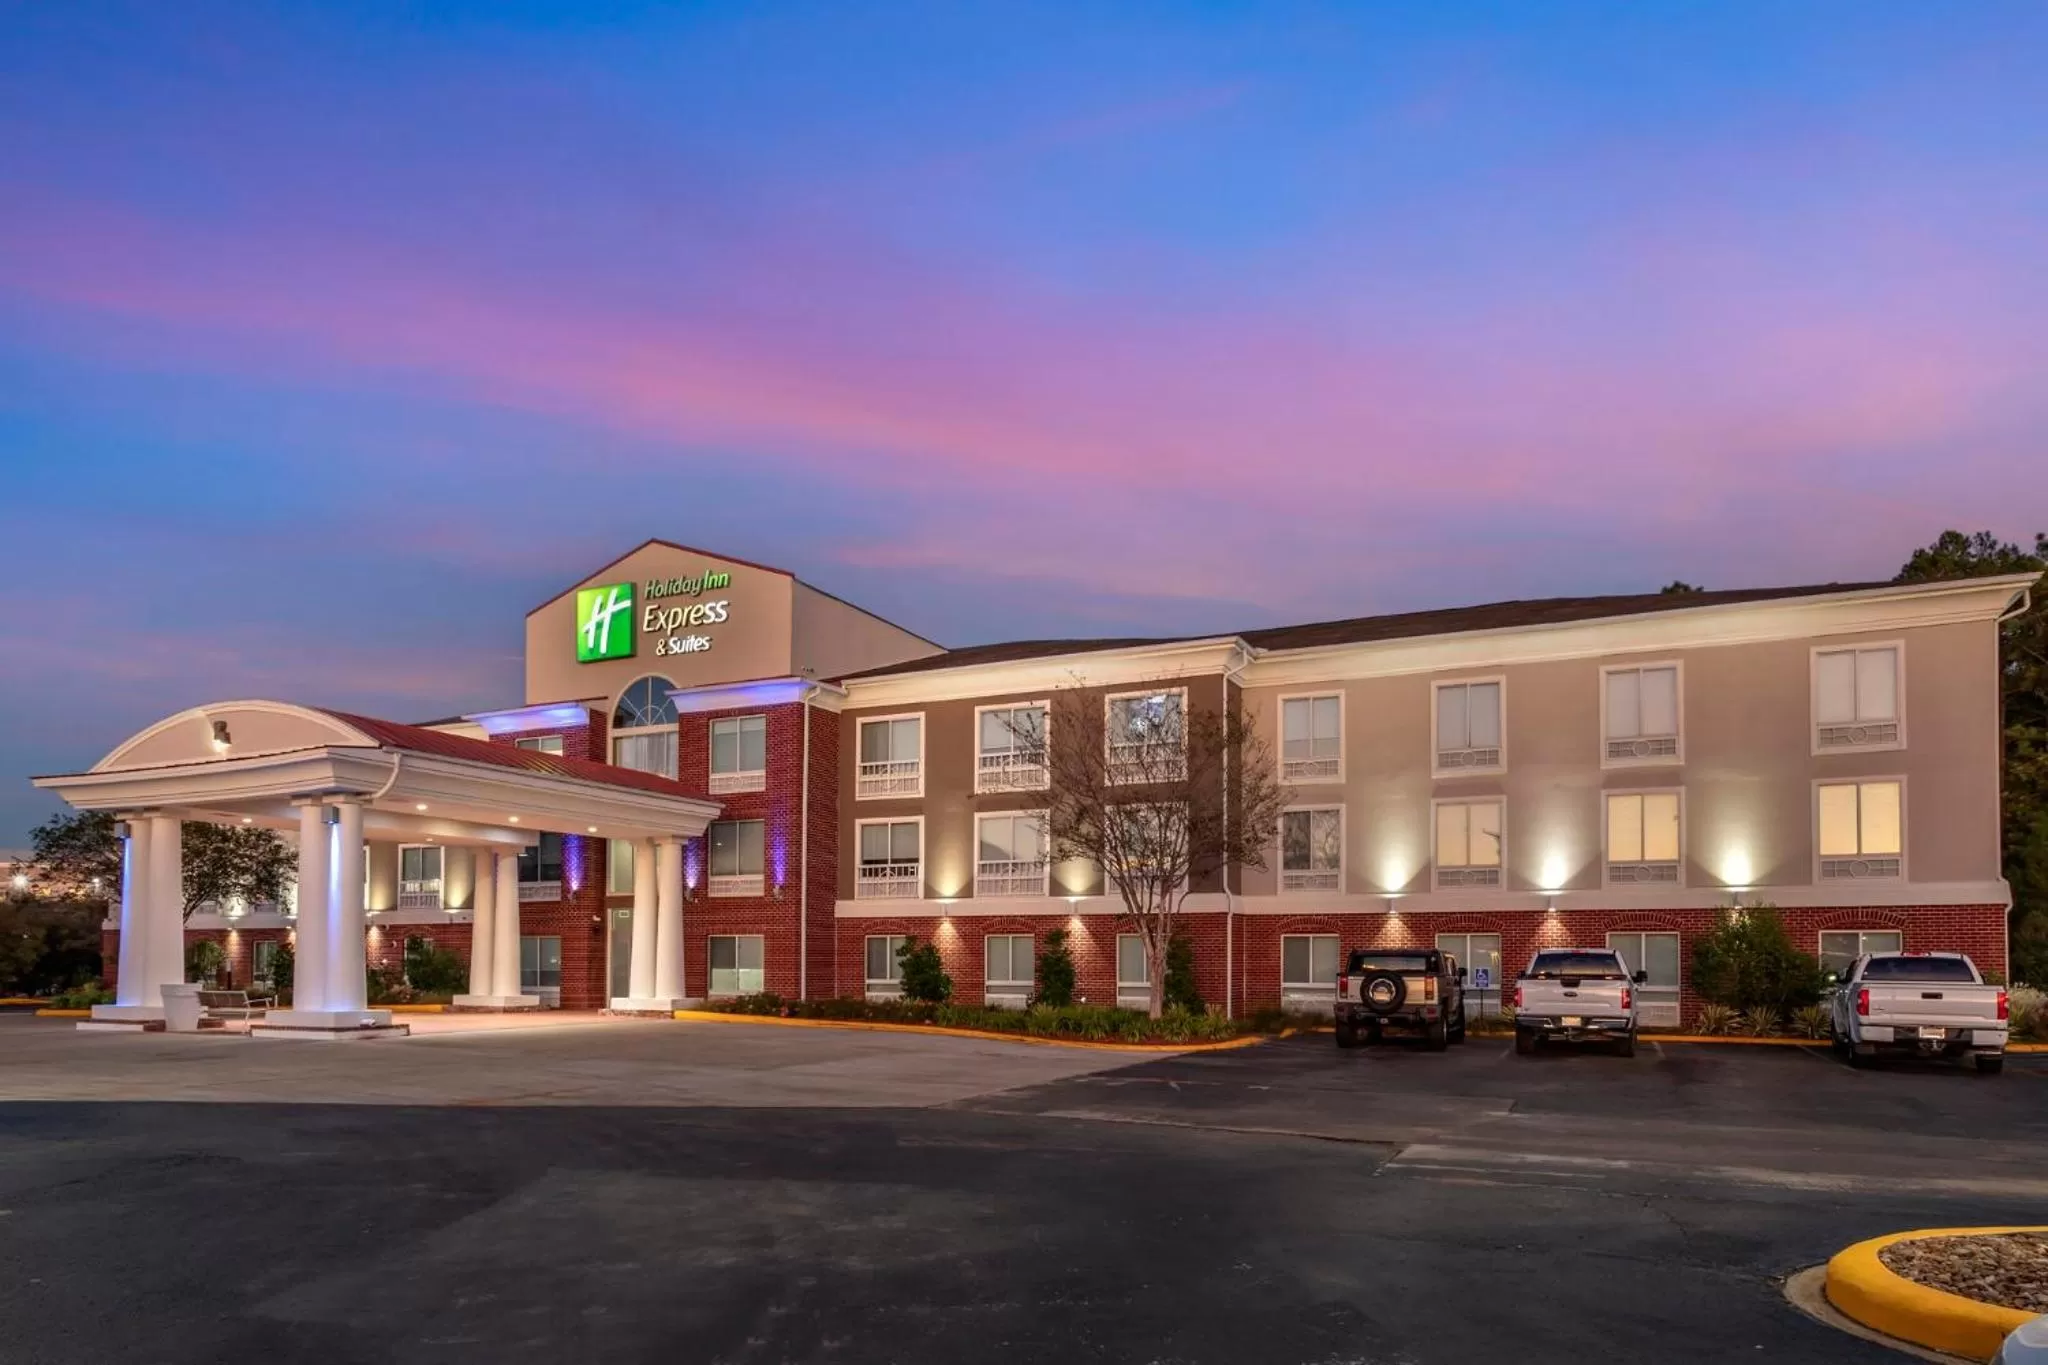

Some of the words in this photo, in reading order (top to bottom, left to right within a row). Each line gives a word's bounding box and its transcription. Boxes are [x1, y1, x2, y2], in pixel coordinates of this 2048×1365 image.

[644, 575, 702, 599] Holiday
[703, 569, 730, 589] Inn
[582, 587, 632, 654] H
[642, 600, 729, 636] Express
[656, 638, 667, 656] &
[668, 635, 711, 655] Suites
